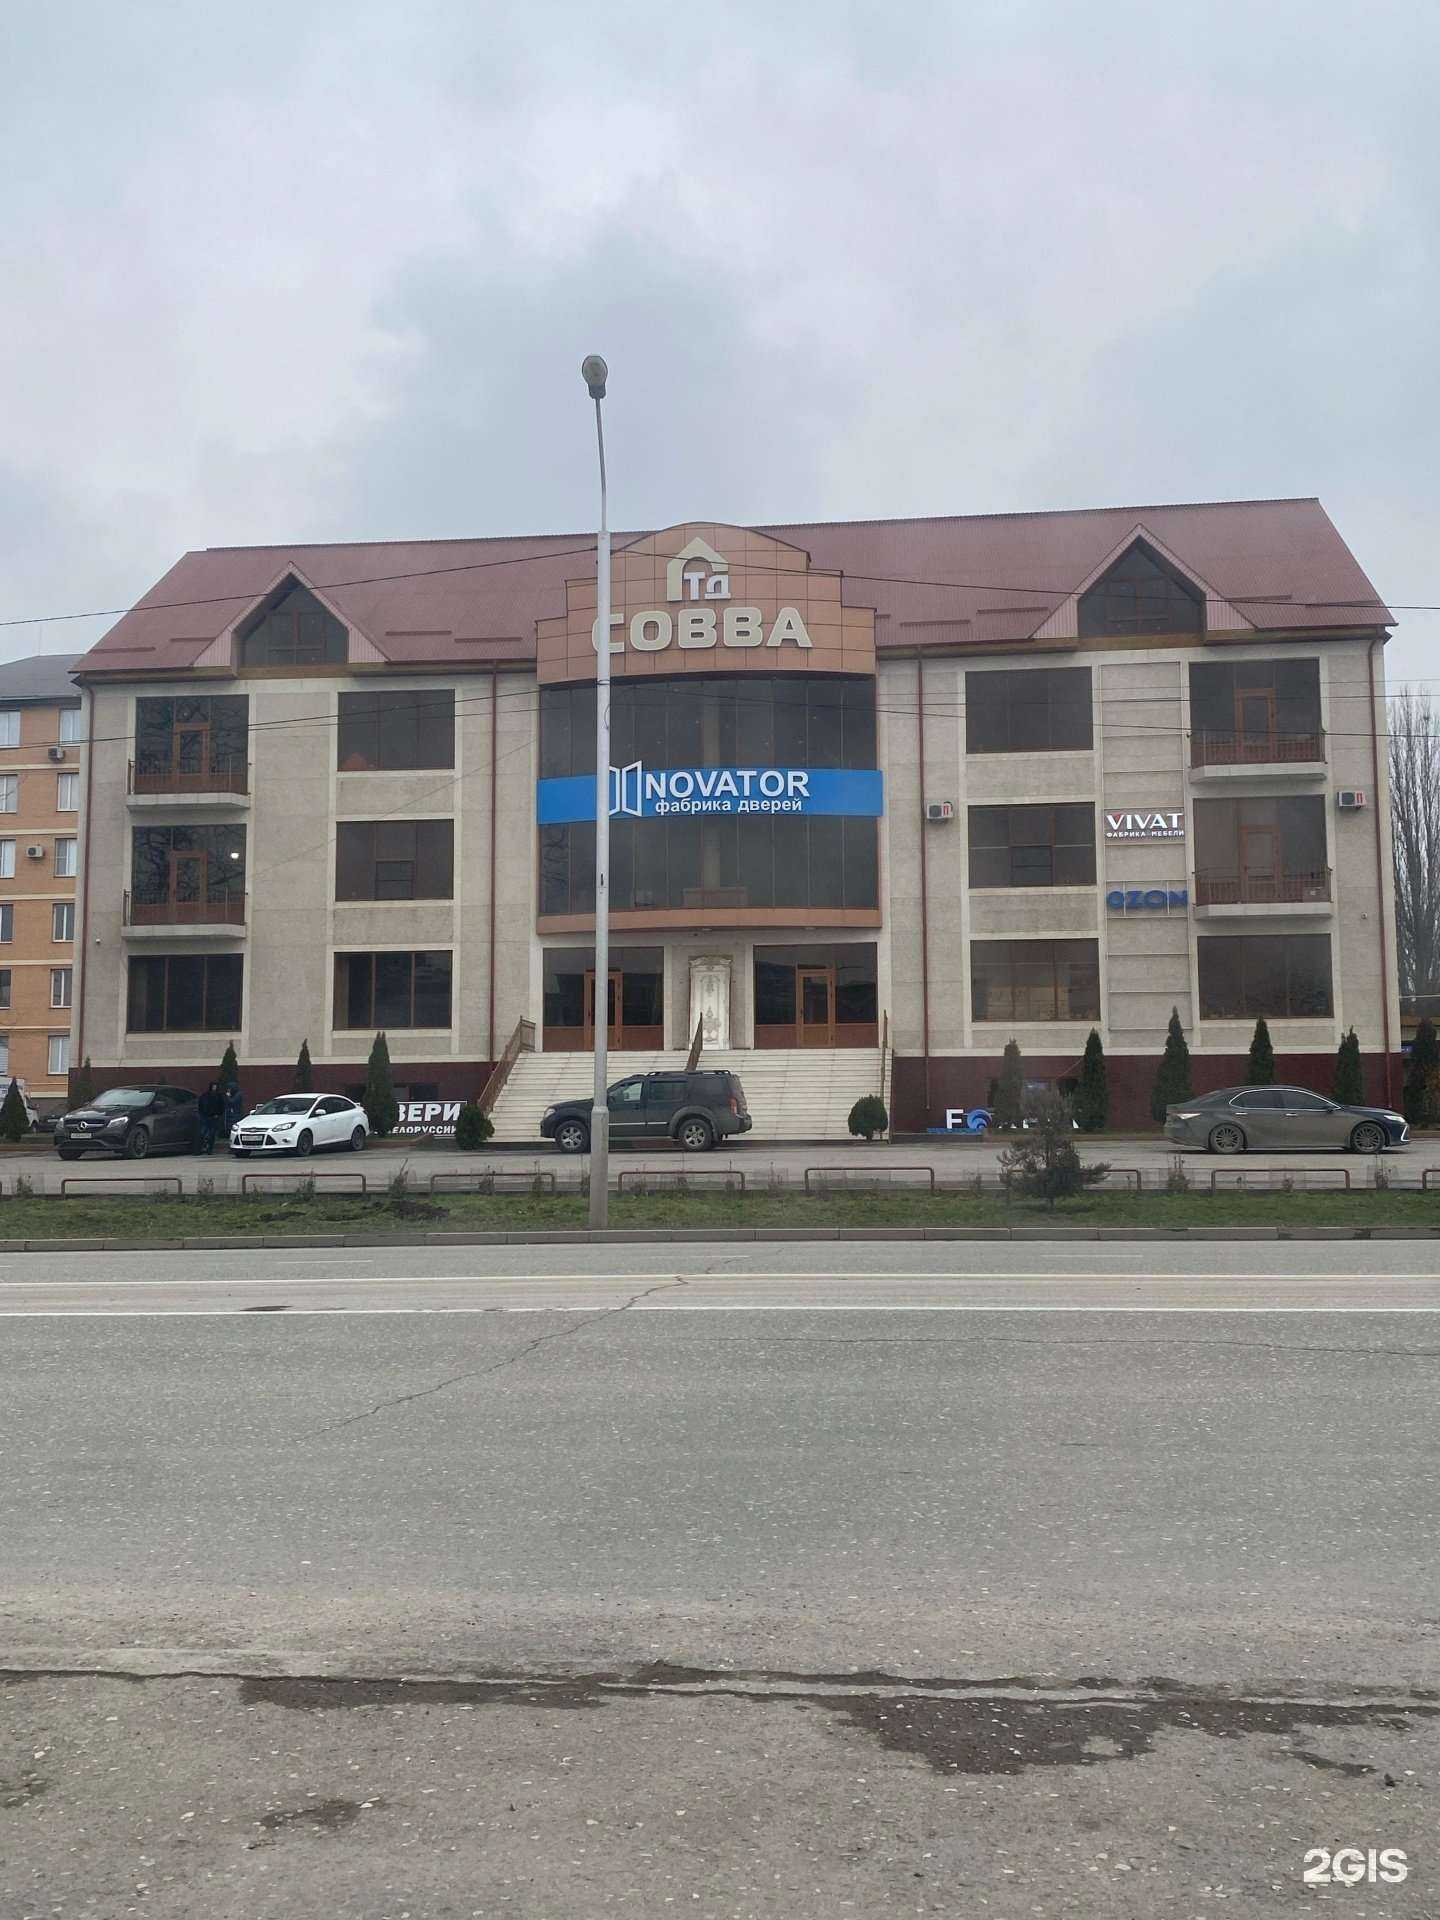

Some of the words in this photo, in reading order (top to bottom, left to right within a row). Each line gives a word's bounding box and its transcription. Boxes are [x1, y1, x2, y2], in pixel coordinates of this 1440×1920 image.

[592, 606, 813, 654] СОВВА
[645, 770, 810, 799] NOVATOR
[655, 797, 731, 815] фабрика
[737, 798, 802, 813] дверей
[1106, 813, 1183, 830] VIVAT
[1107, 890, 1188, 909] OZON
